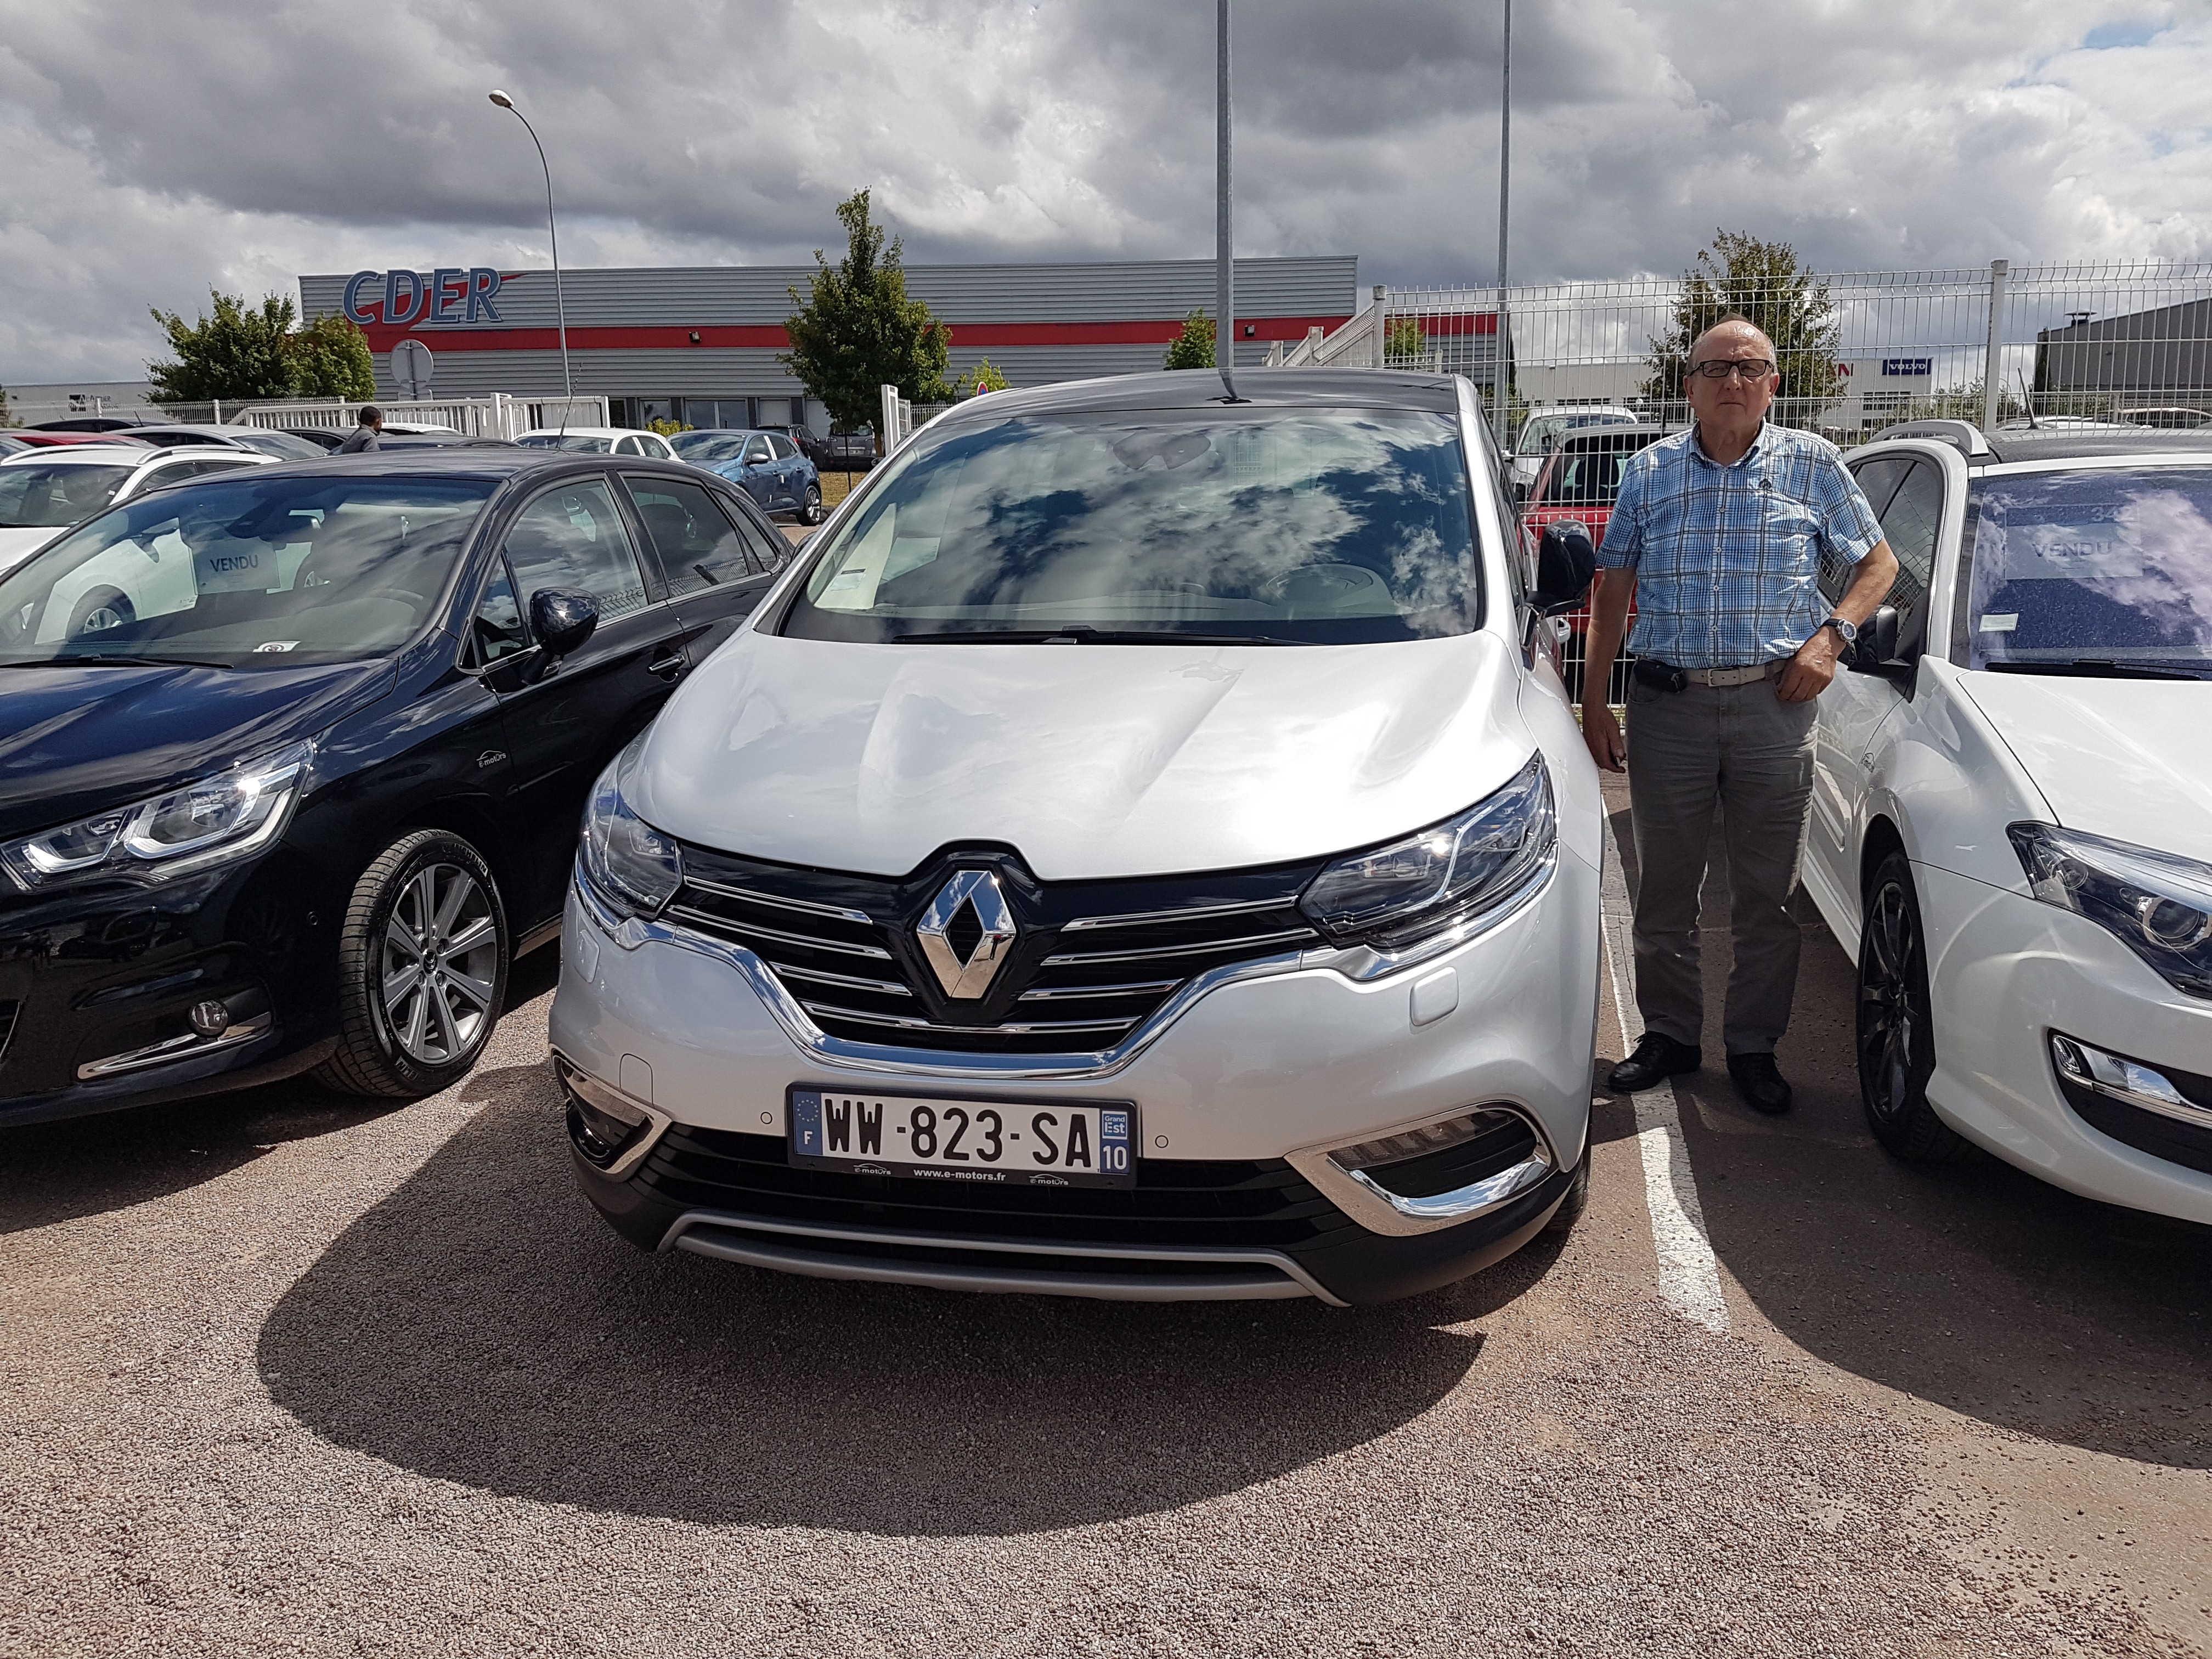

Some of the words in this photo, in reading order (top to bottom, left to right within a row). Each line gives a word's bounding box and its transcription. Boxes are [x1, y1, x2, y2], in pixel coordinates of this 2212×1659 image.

[342, 267, 503, 324] CDER
[2032, 541, 2112, 557] VENDU
[210, 554, 258, 572] VENDU
[1104, 1122, 1125, 1134] Est
[804, 1131, 813, 1145] F
[1103, 1145, 1127, 1170] 10
[913, 1169, 1006, 1181] www.e-motors.fr
